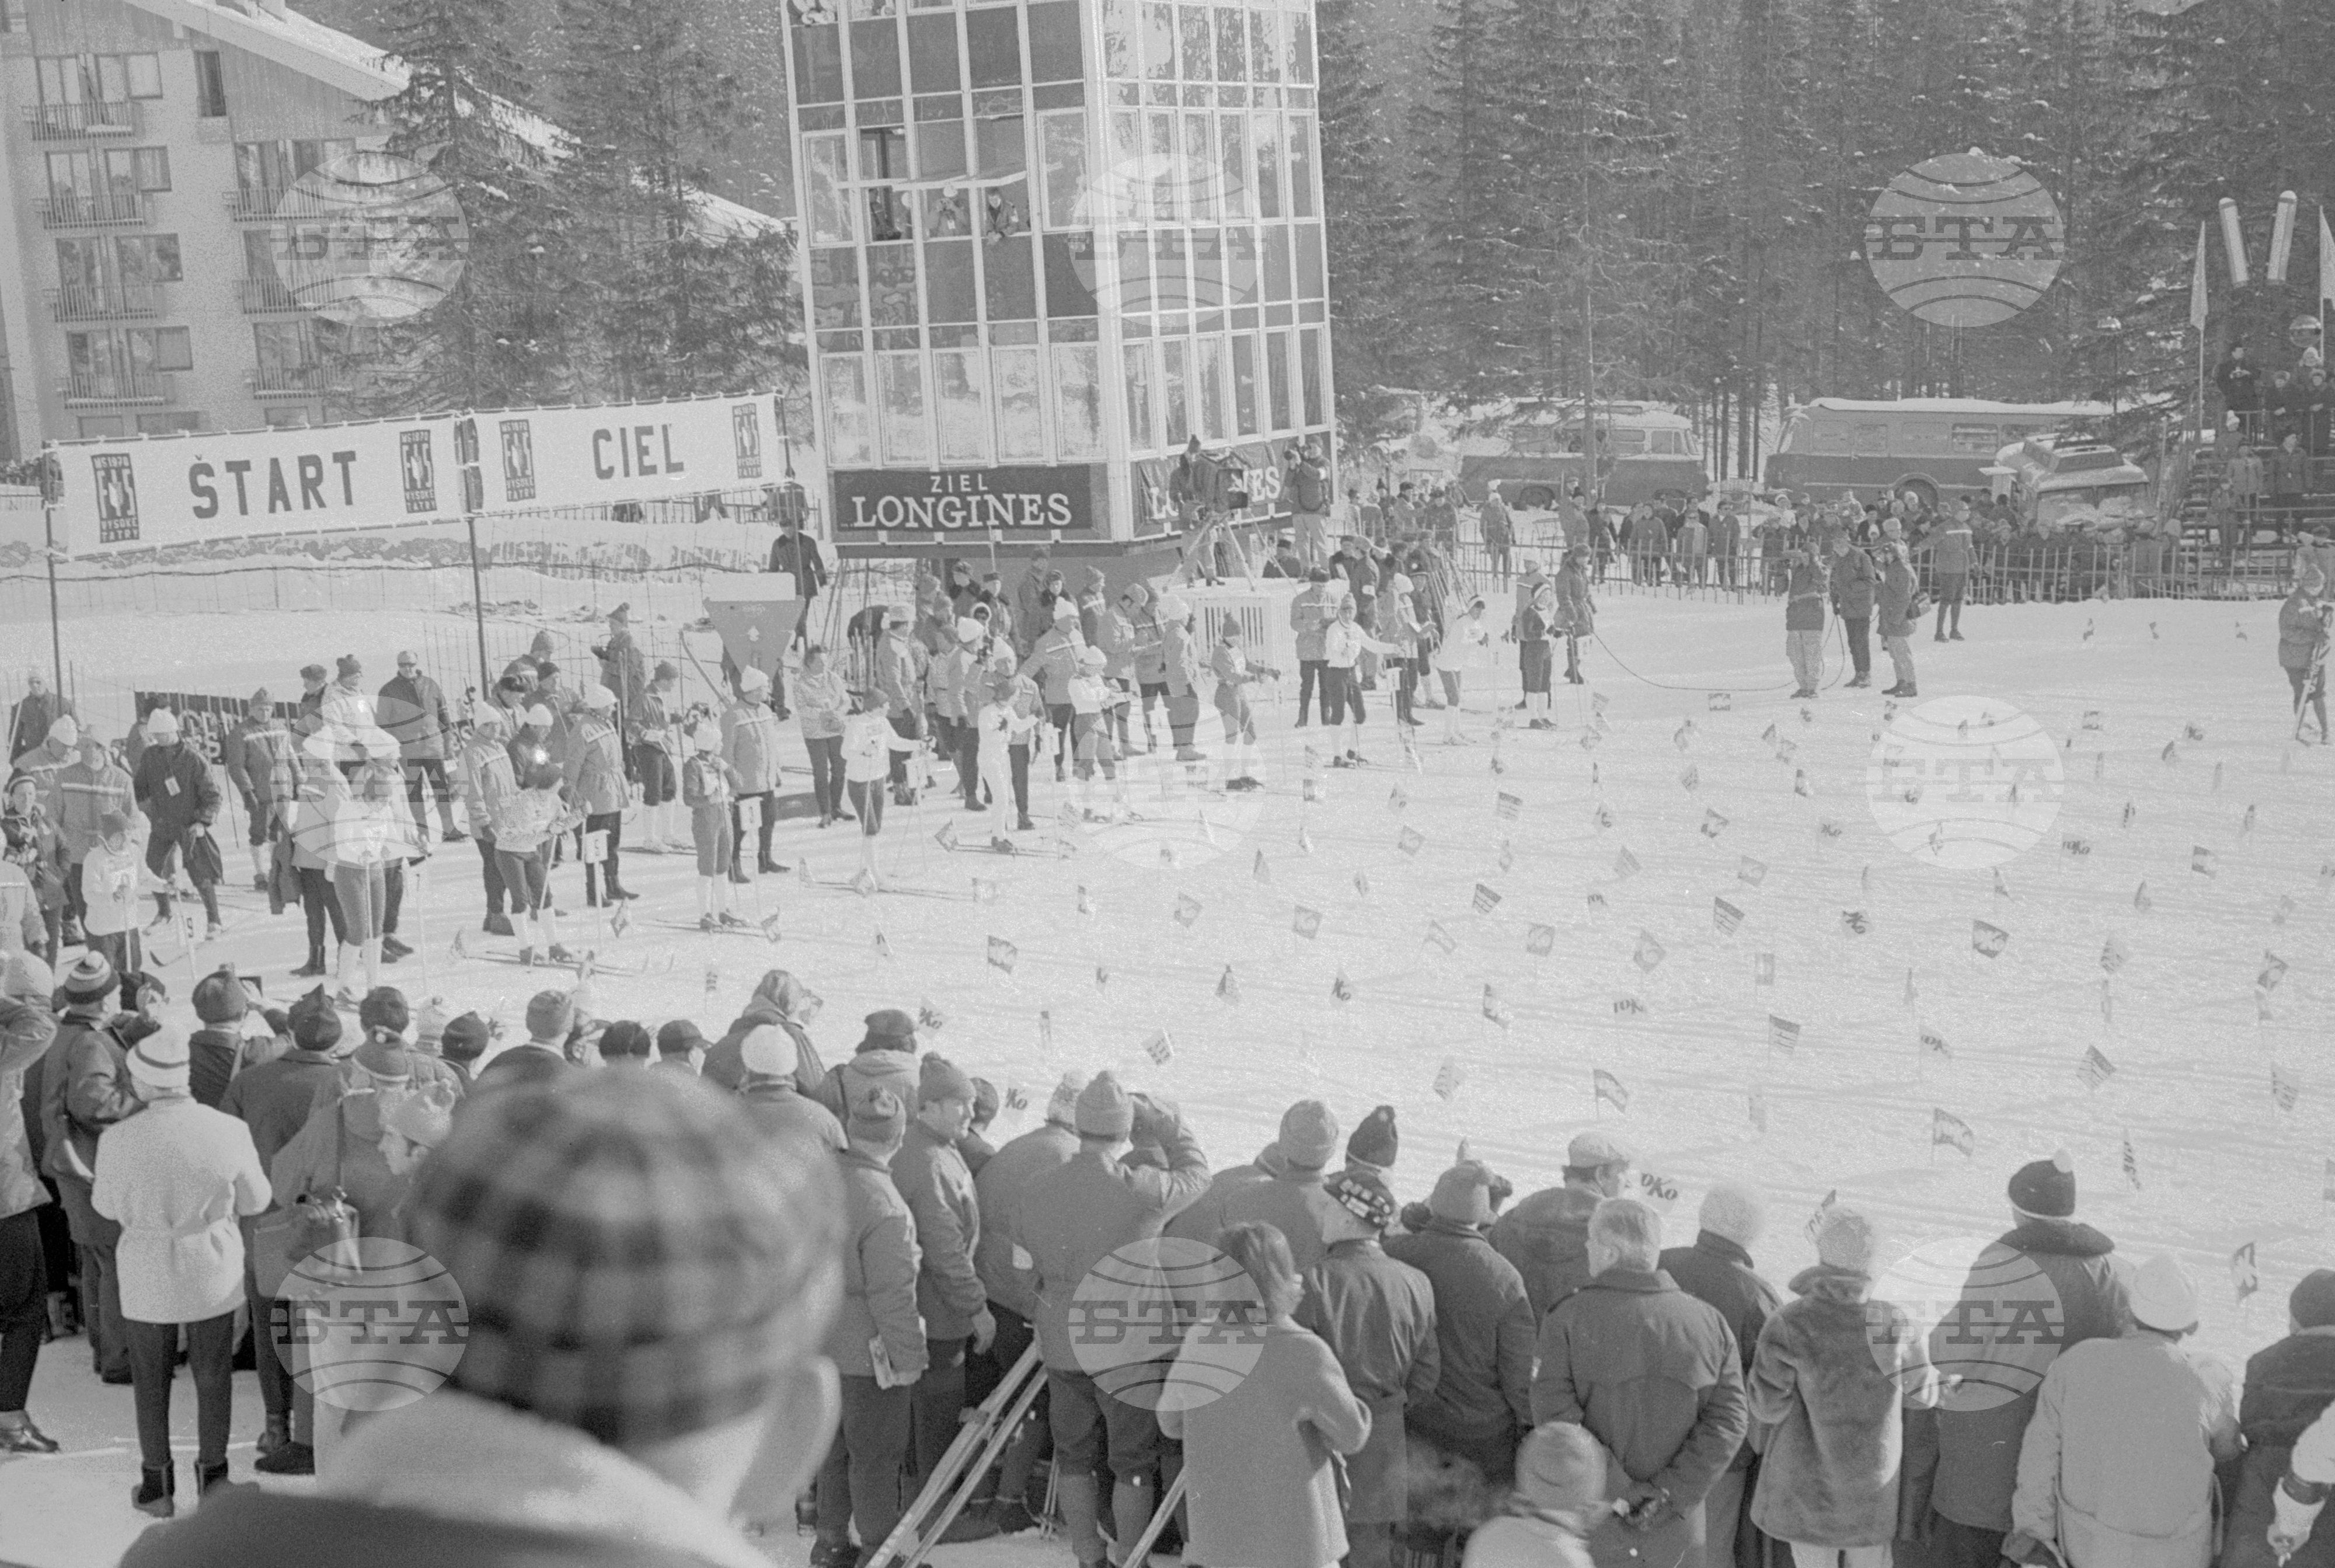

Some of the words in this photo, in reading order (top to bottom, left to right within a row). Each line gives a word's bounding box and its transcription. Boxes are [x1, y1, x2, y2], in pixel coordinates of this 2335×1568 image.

[189, 450, 356, 519] ŠTART
[930, 473, 988, 493] ZIEL
[851, 492, 1072, 528] LONGINES
